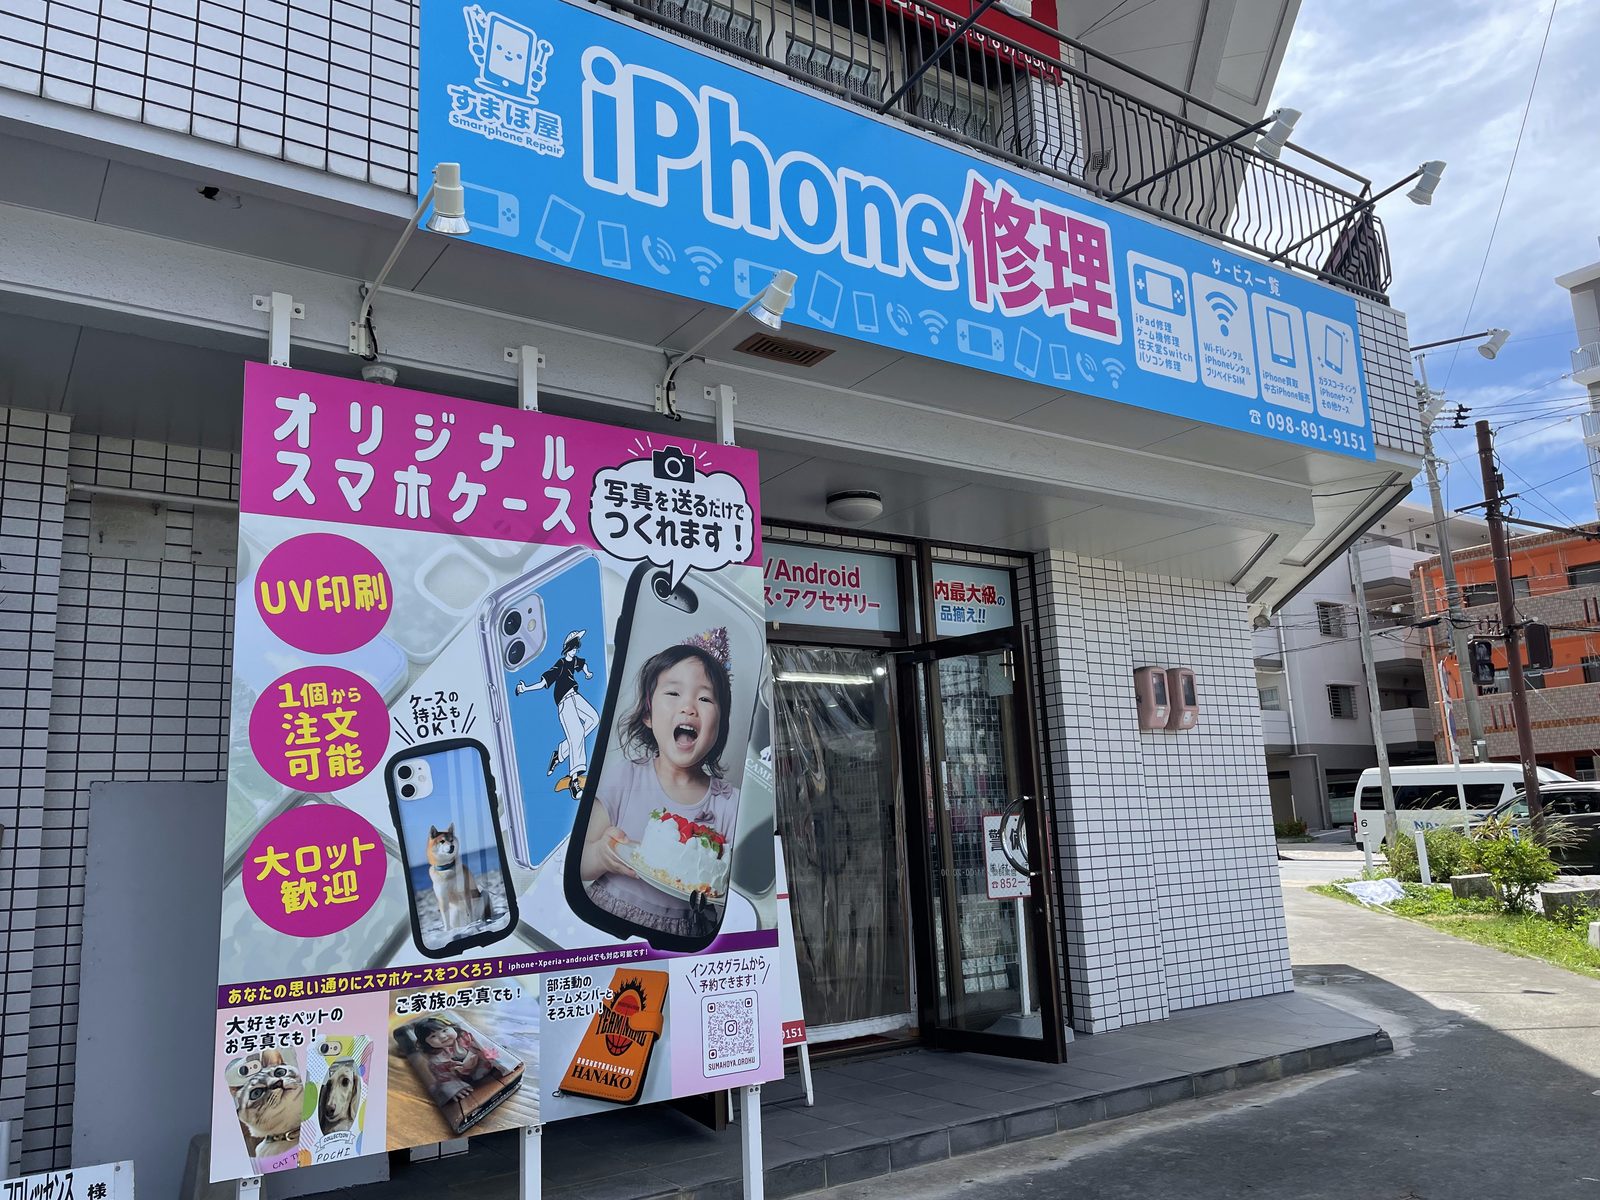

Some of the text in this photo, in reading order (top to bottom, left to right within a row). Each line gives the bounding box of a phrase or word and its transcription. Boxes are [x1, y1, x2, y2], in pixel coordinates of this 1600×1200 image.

[448, 86, 562, 142] すまほ屋
[452, 114, 563, 156] Smartphone Repair
[582, 46, 1122, 344] iPhone修理
[1211, 257, 1281, 297] サービス一覧
[1135, 312, 1173, 334] iPad修理
[1136, 326, 1180, 348] ゲーム機修理
[1138, 339, 1193, 363] 任天堂Switch
[1139, 352, 1182, 372] パソコン修理
[1203, 342, 1244, 361] Wi-Fiレンタル
[1204, 354, 1251, 376] iPhoneレンタル
[1262, 370, 1299, 389] iPhone買取
[274, 392, 576, 482] オリジナル
[1266, 411, 1367, 451] 098-891-9151
[272, 450, 577, 534] スマホケース
[604, 478, 745, 521] 写真を送るだけで
[604, 511, 743, 553] つくれます！
[260, 572, 388, 615] UV印刷
[278, 682, 362, 709] 1個から
[409, 690, 459, 712] ケースの
[281, 706, 360, 746] 注文
[412, 706, 461, 725] 持込も
[284, 742, 365, 781] 可能
[1360, 818, 1368, 828] 6
[253, 836, 376, 881] 大ロット
[280, 870, 360, 914] 歓迎
[691, 955, 766, 978] インスタグラムから
[546, 975, 592, 992] 部活動の
[699, 973, 757, 993] 予約できます!
[396, 986, 521, 1014] ご家族の写真でも！
[546, 988, 613, 1007] チームメンバーと
[226, 1007, 343, 1036] 大好きなペットの
[546, 1001, 604, 1021] そろえたい！
[225, 1028, 317, 1055] お写真でも！
[708, 1056, 756, 1071] SUMAHOYA.OROKU
[571, 1064, 632, 1090] HANAKO
[323, 1132, 350, 1143] COLLECTION
[272, 1157, 289, 1170] CAT
[316, 1147, 351, 1163] POCHI
[87, 1181, 107, 1199] 様
